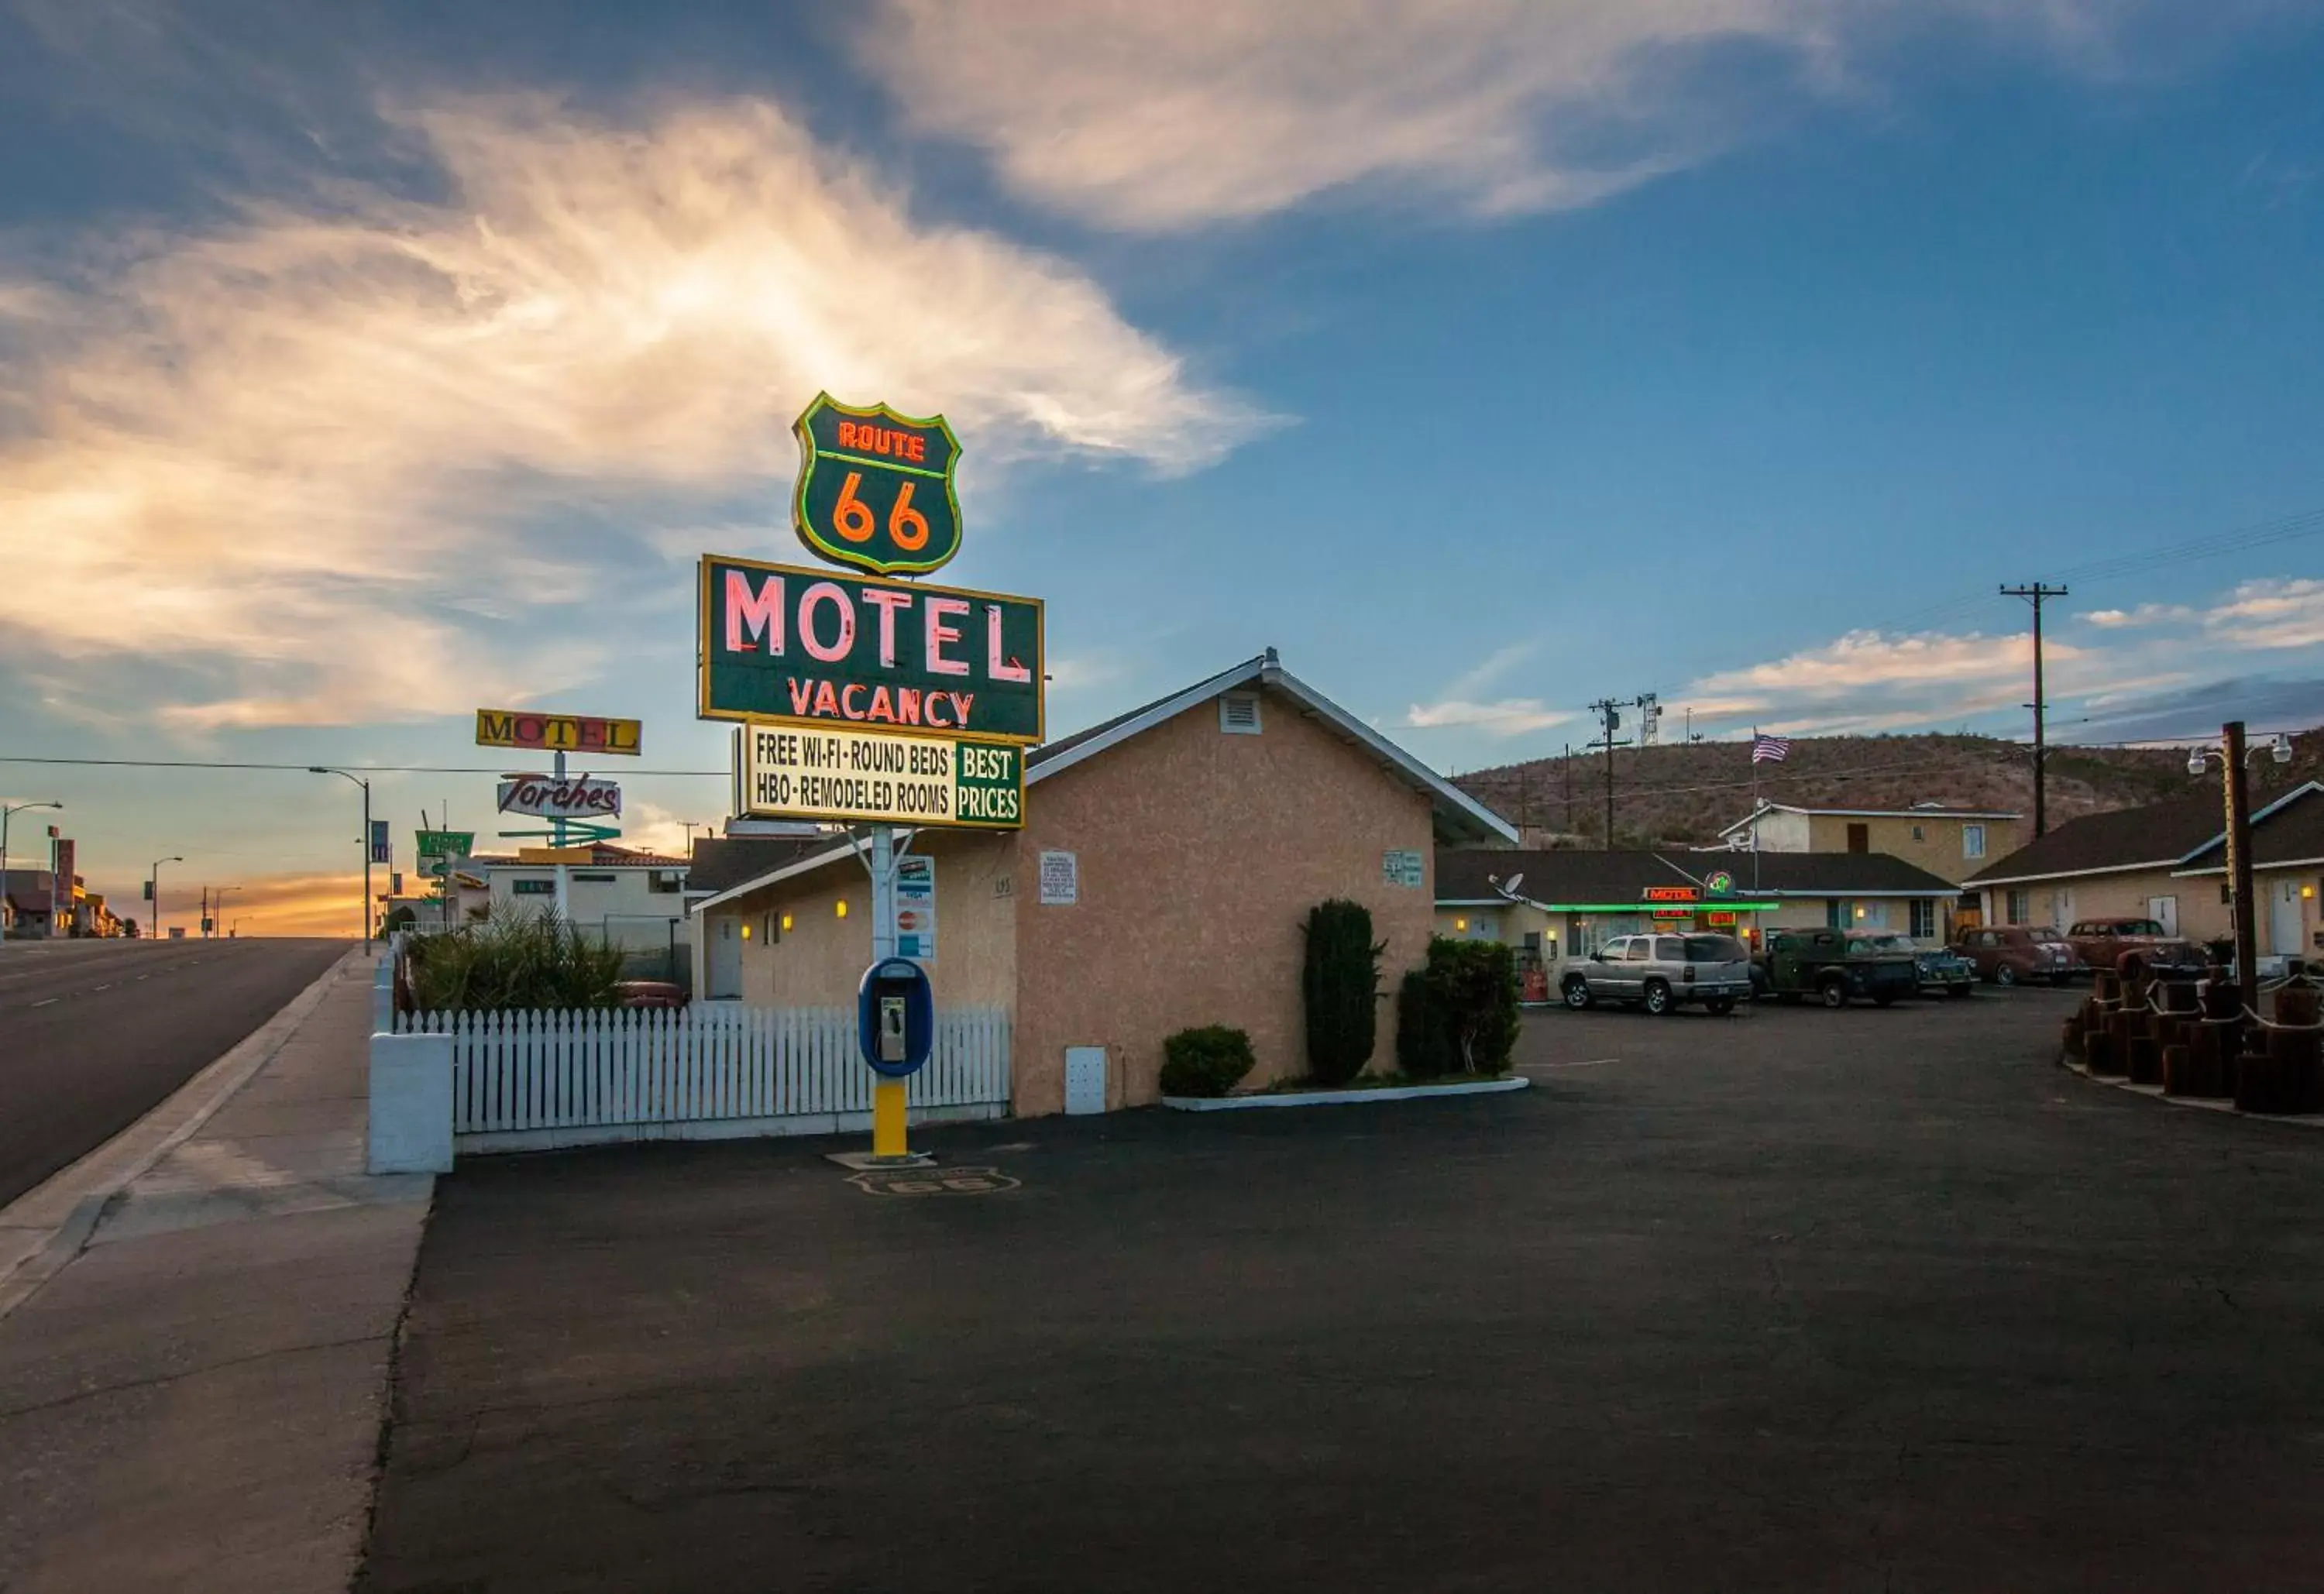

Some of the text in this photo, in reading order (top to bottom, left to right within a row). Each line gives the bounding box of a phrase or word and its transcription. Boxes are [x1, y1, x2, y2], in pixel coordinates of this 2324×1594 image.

[839, 421, 925, 462] ROUTE
[833, 471, 929, 551] 66
[725, 569, 1031, 683] MOTEL
[787, 676, 974, 729] VACANCY
[481, 713, 637, 748] MOTEL
[756, 733, 797, 766] FREE
[851, 740, 905, 774] ROUND
[910, 744, 948, 777] BEDS
[962, 746, 1012, 780] BEST
[498, 771, 620, 816] Torches
[756, 772, 948, 814] HBO REMODELED ROOMS
[957, 785, 1019, 819] PRICES
